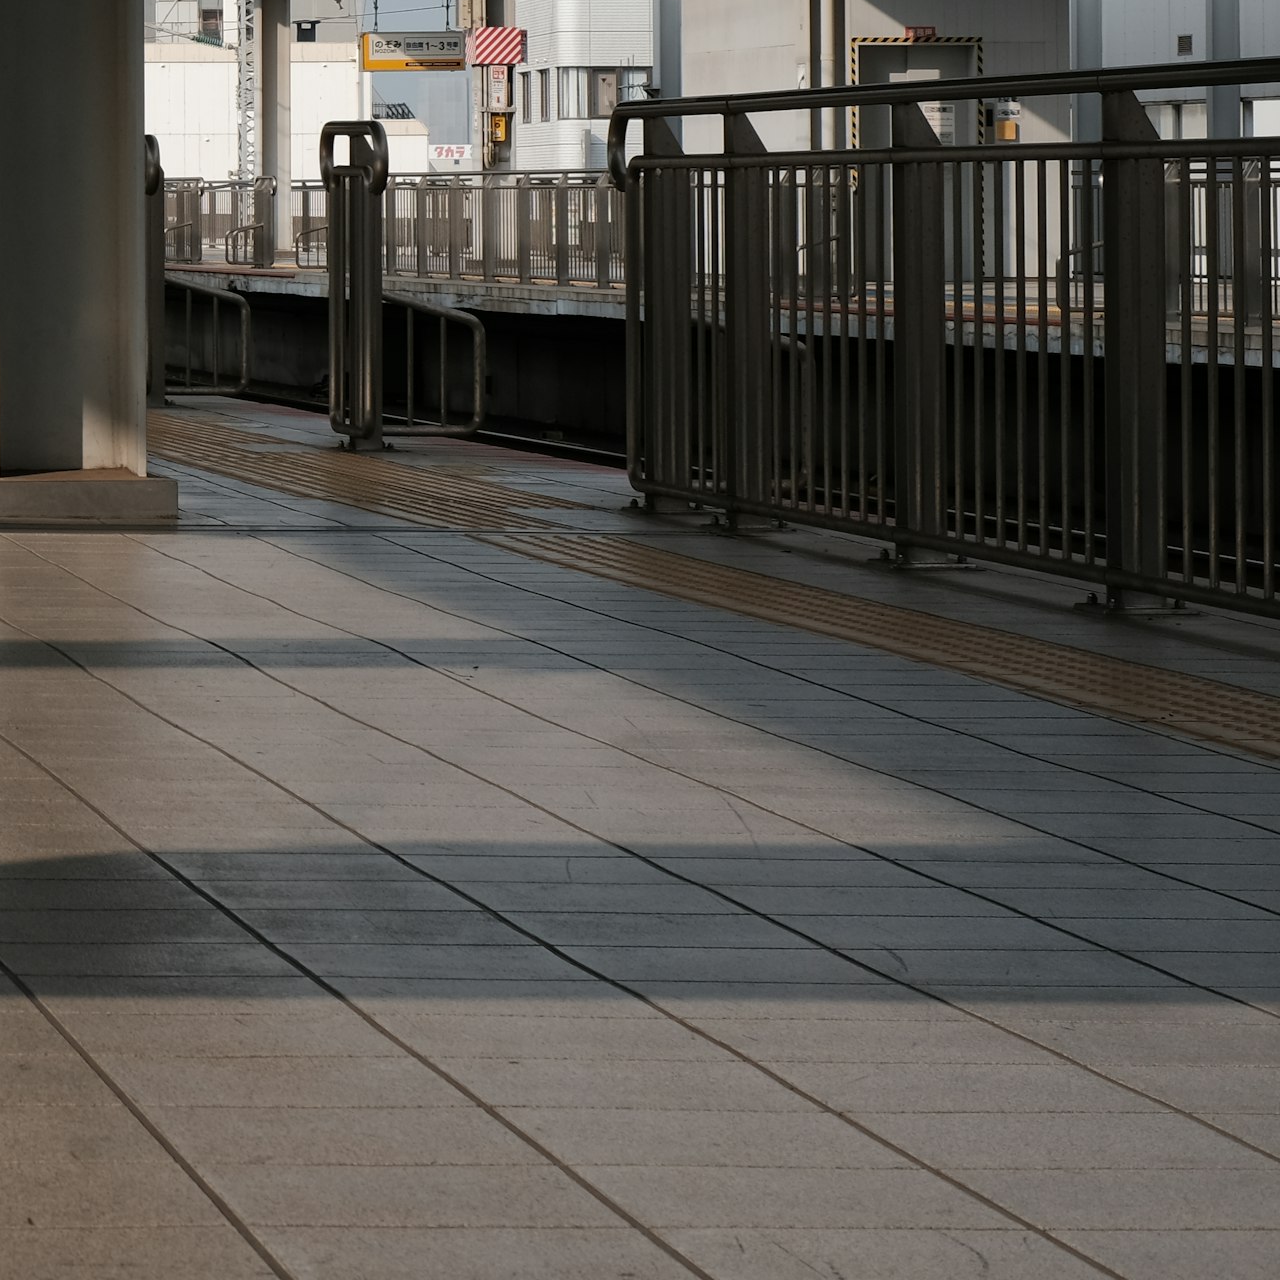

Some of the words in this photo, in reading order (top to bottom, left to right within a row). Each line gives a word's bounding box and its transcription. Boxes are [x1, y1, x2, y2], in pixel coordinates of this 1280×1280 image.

[375, 40, 402, 49] のぞみ
[434, 146, 465, 158] タカラ
